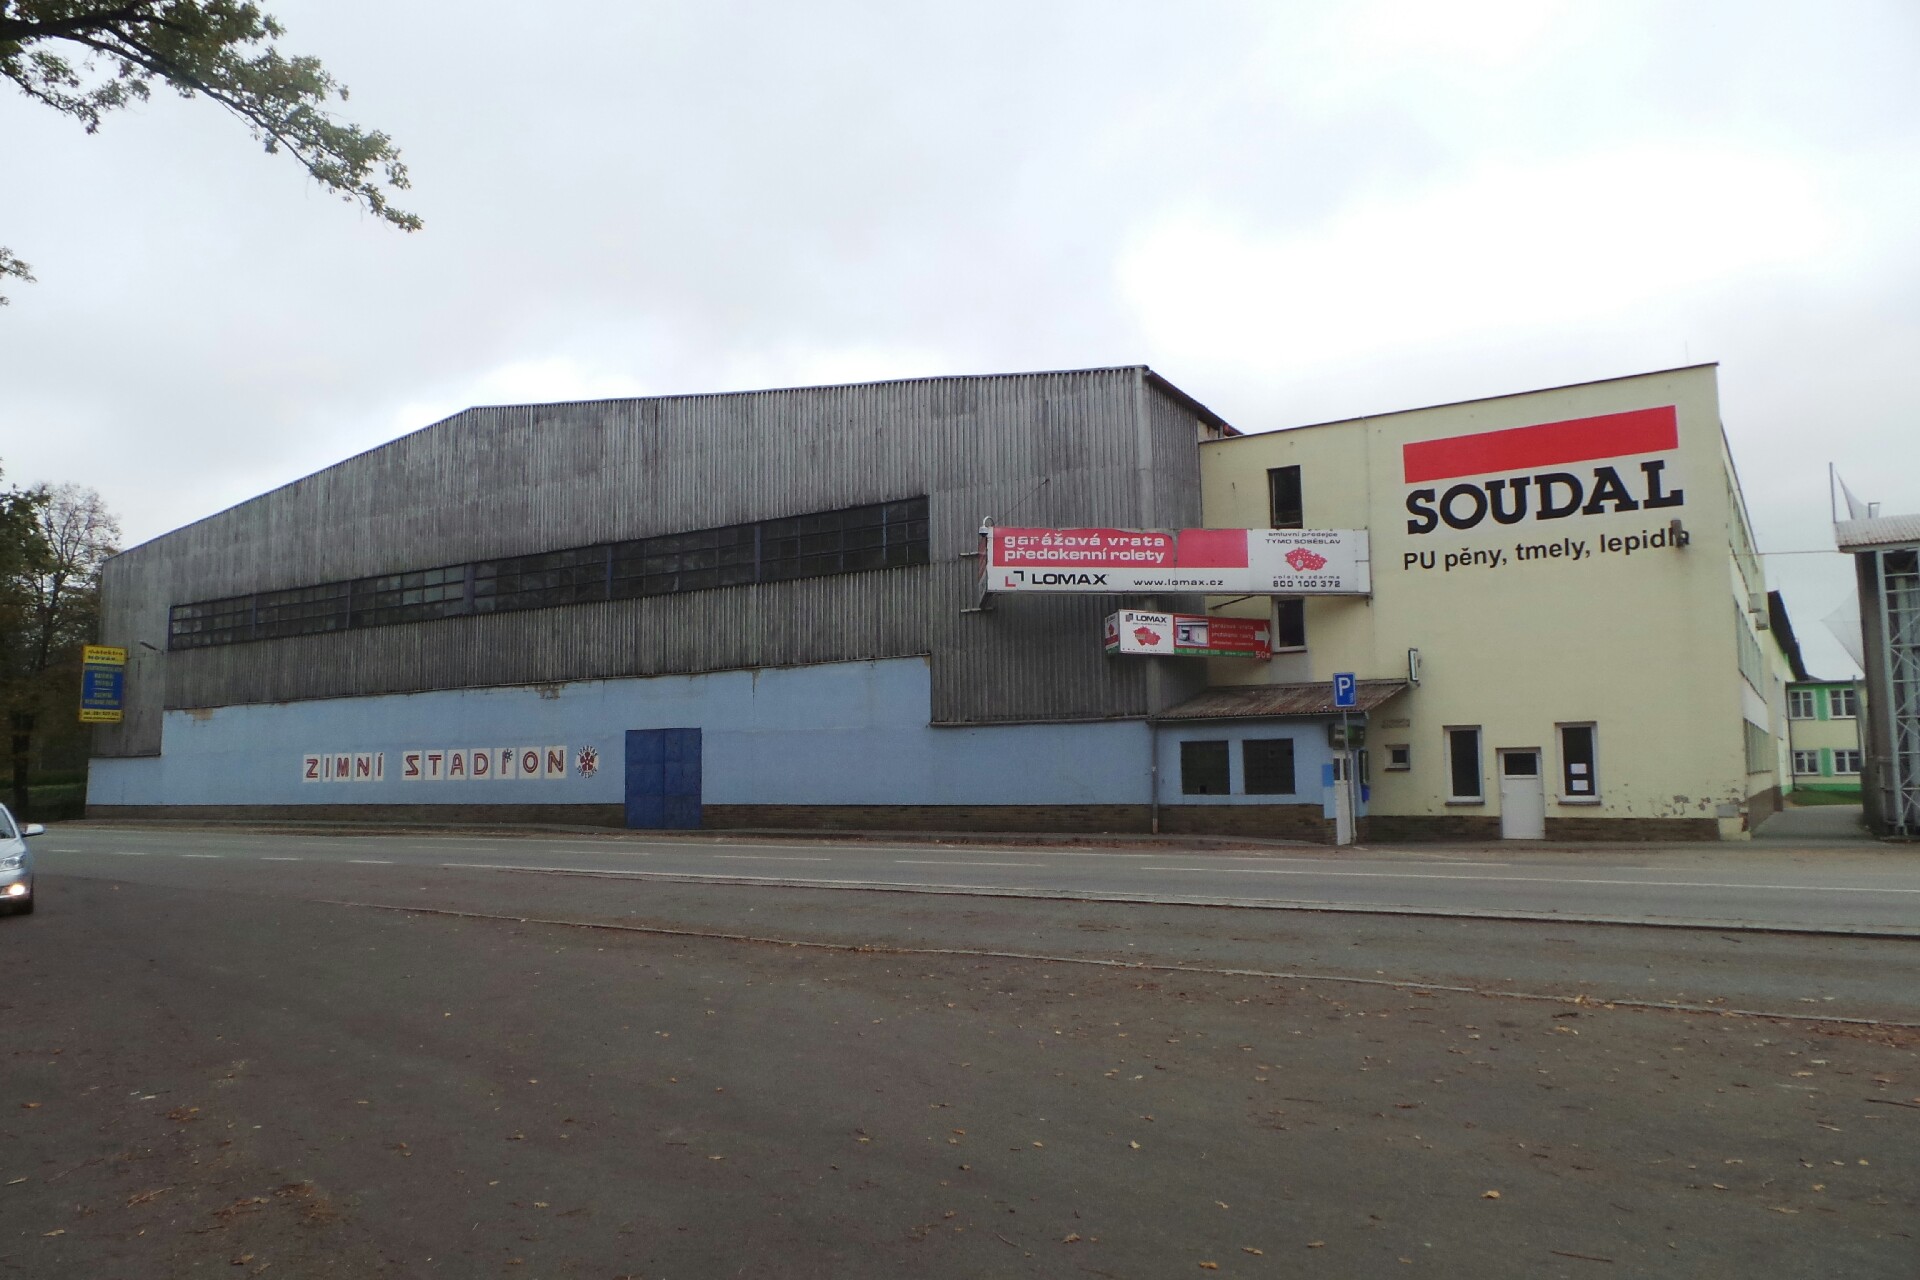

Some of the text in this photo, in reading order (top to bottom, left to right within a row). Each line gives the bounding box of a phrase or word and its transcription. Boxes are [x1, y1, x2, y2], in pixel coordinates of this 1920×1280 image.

[1406, 459, 1684, 535] SOUDAL
[1004, 533, 1165, 548] garážová vrata
[1004, 548, 1165, 563] předokenní rolety
[1404, 551, 1436, 571] PU
[1445, 547, 1508, 572] pěny,
[1517, 537, 1591, 561] tmely,
[1032, 573, 1108, 585] LOMAX
[1133, 578, 1224, 587] www.lomax.cz
[1273, 580, 1341, 588] 800 100 372
[1136, 614, 1167, 623] LOMAX
[1338, 677, 1350, 696] P
[305, 751, 565, 779] ZIMNÍ STADION
